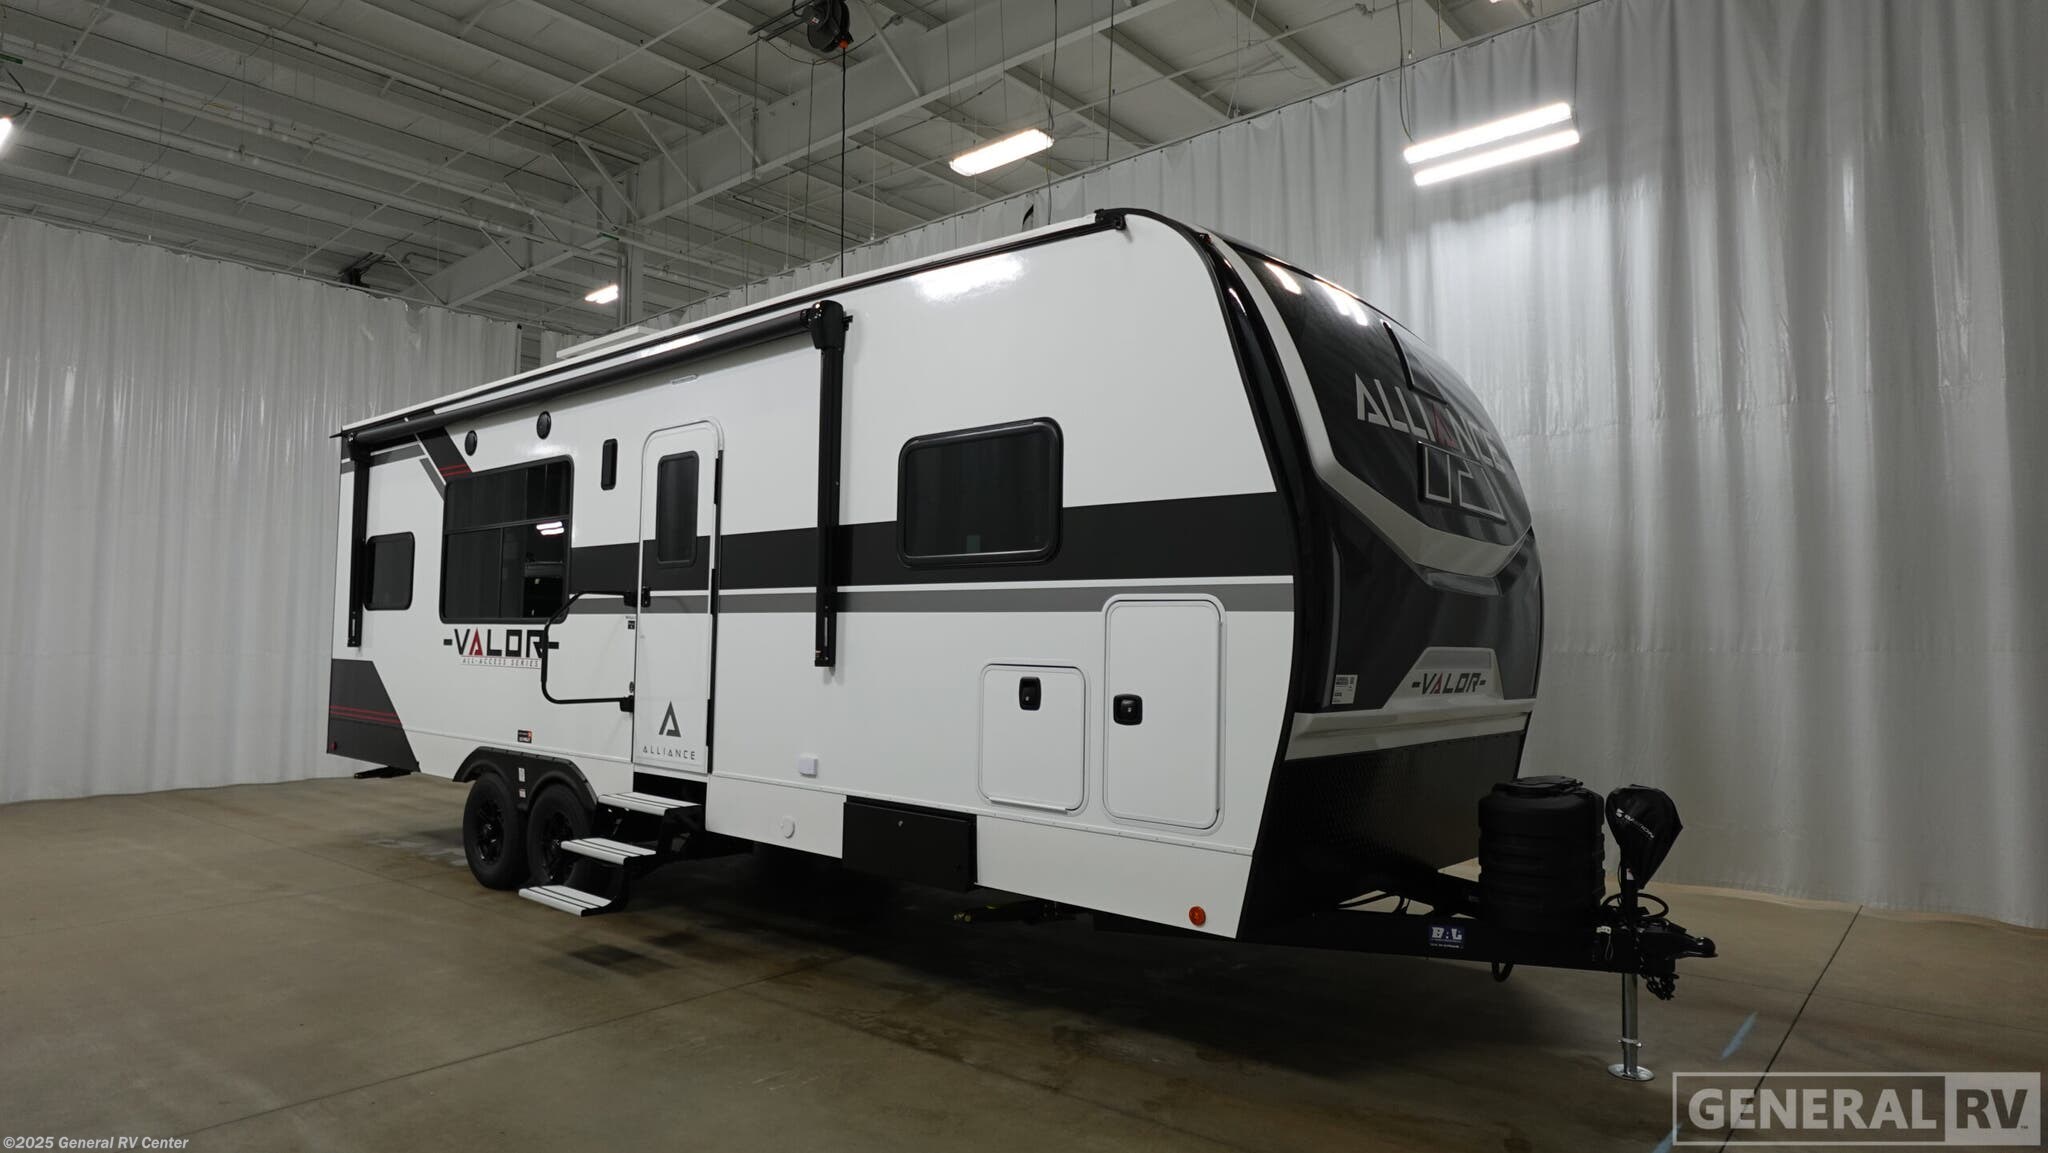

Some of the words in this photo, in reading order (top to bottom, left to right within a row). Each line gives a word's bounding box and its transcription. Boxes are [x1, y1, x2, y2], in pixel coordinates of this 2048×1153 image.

[1355, 373, 1506, 473] ALLIANCE
[462, 657, 506, 667] ALL-ACCESS
[510, 658, 540, 669] SERIES
[642, 745, 696, 760] ALLIANCE
